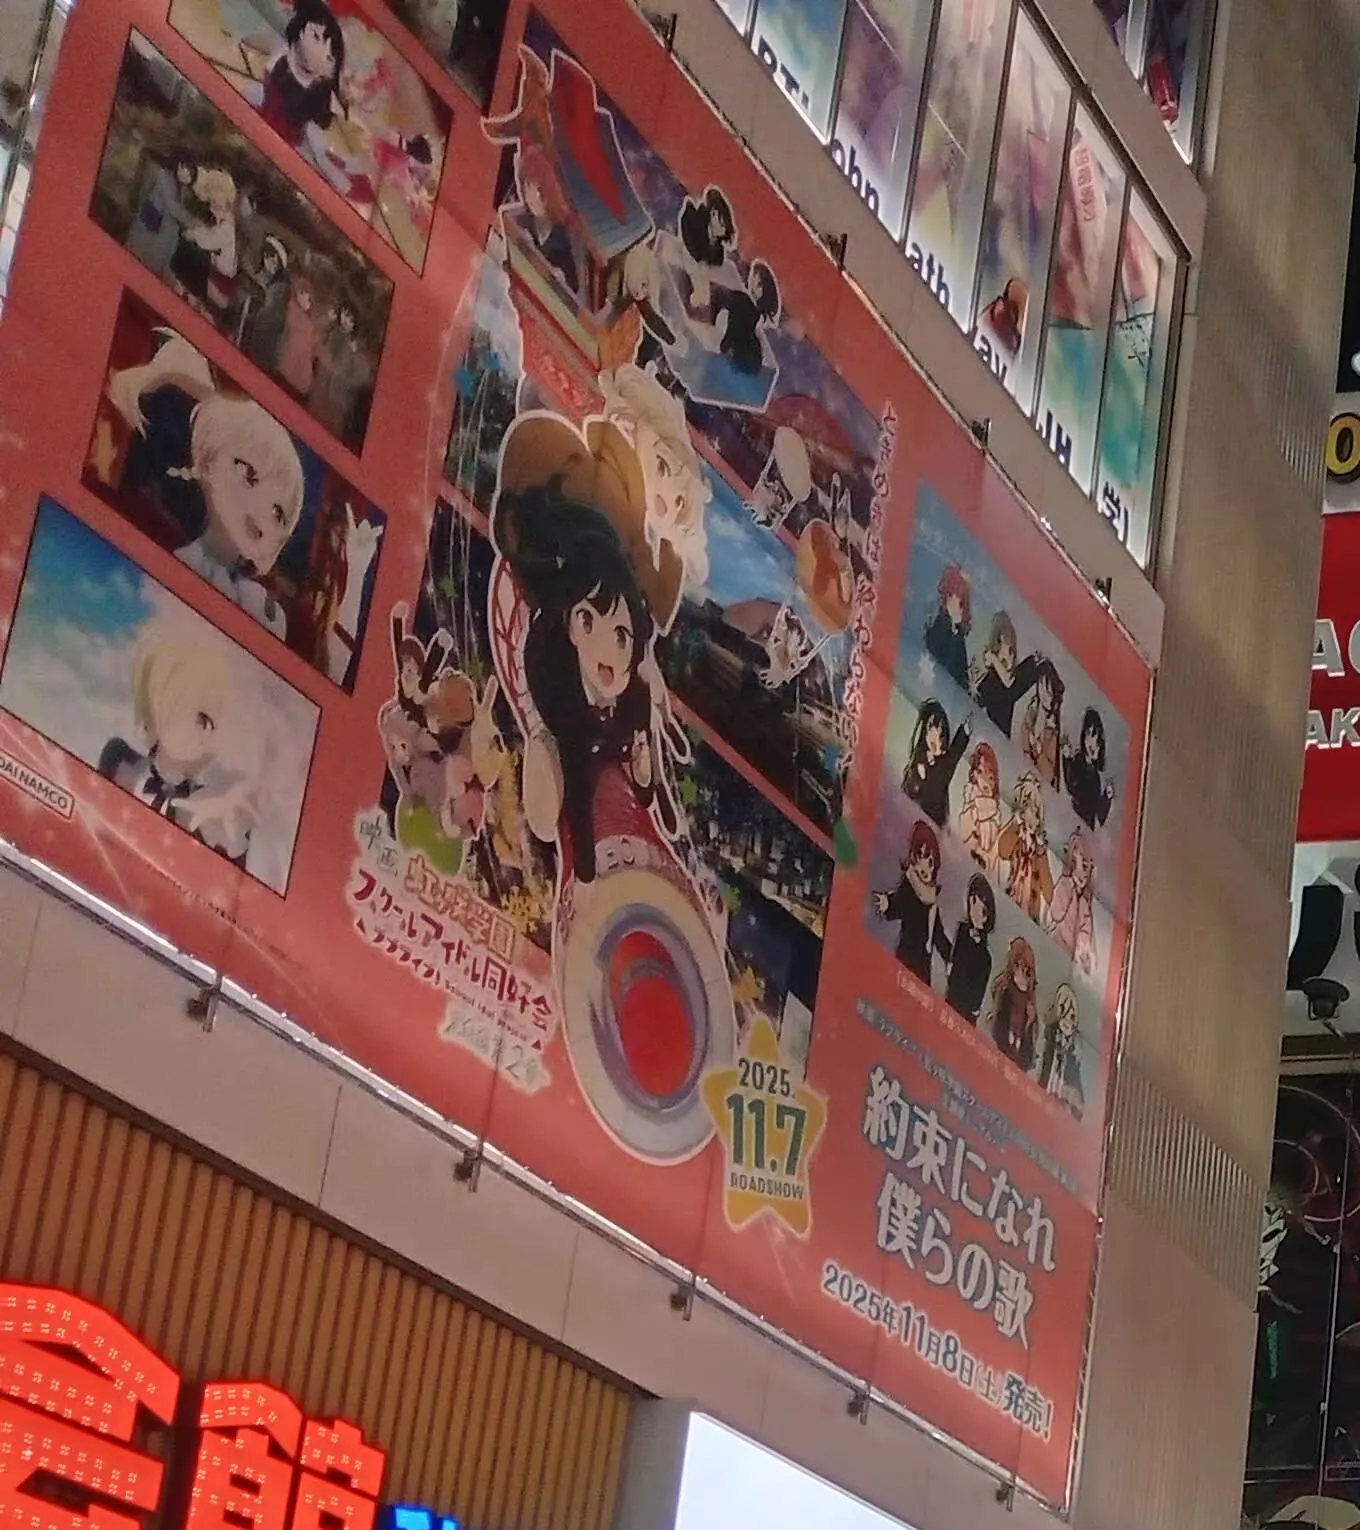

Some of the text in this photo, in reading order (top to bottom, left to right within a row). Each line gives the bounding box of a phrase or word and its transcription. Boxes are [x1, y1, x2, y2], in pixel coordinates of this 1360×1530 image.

[19, 769, 69, 811] NAMCO
[727, 1092, 806, 1178] 11.7
[862, 1064, 1056, 1274] 約束になれ
[730, 1171, 804, 1200] ROADSHOW
[875, 1171, 1035, 1351] 僕らの歌
